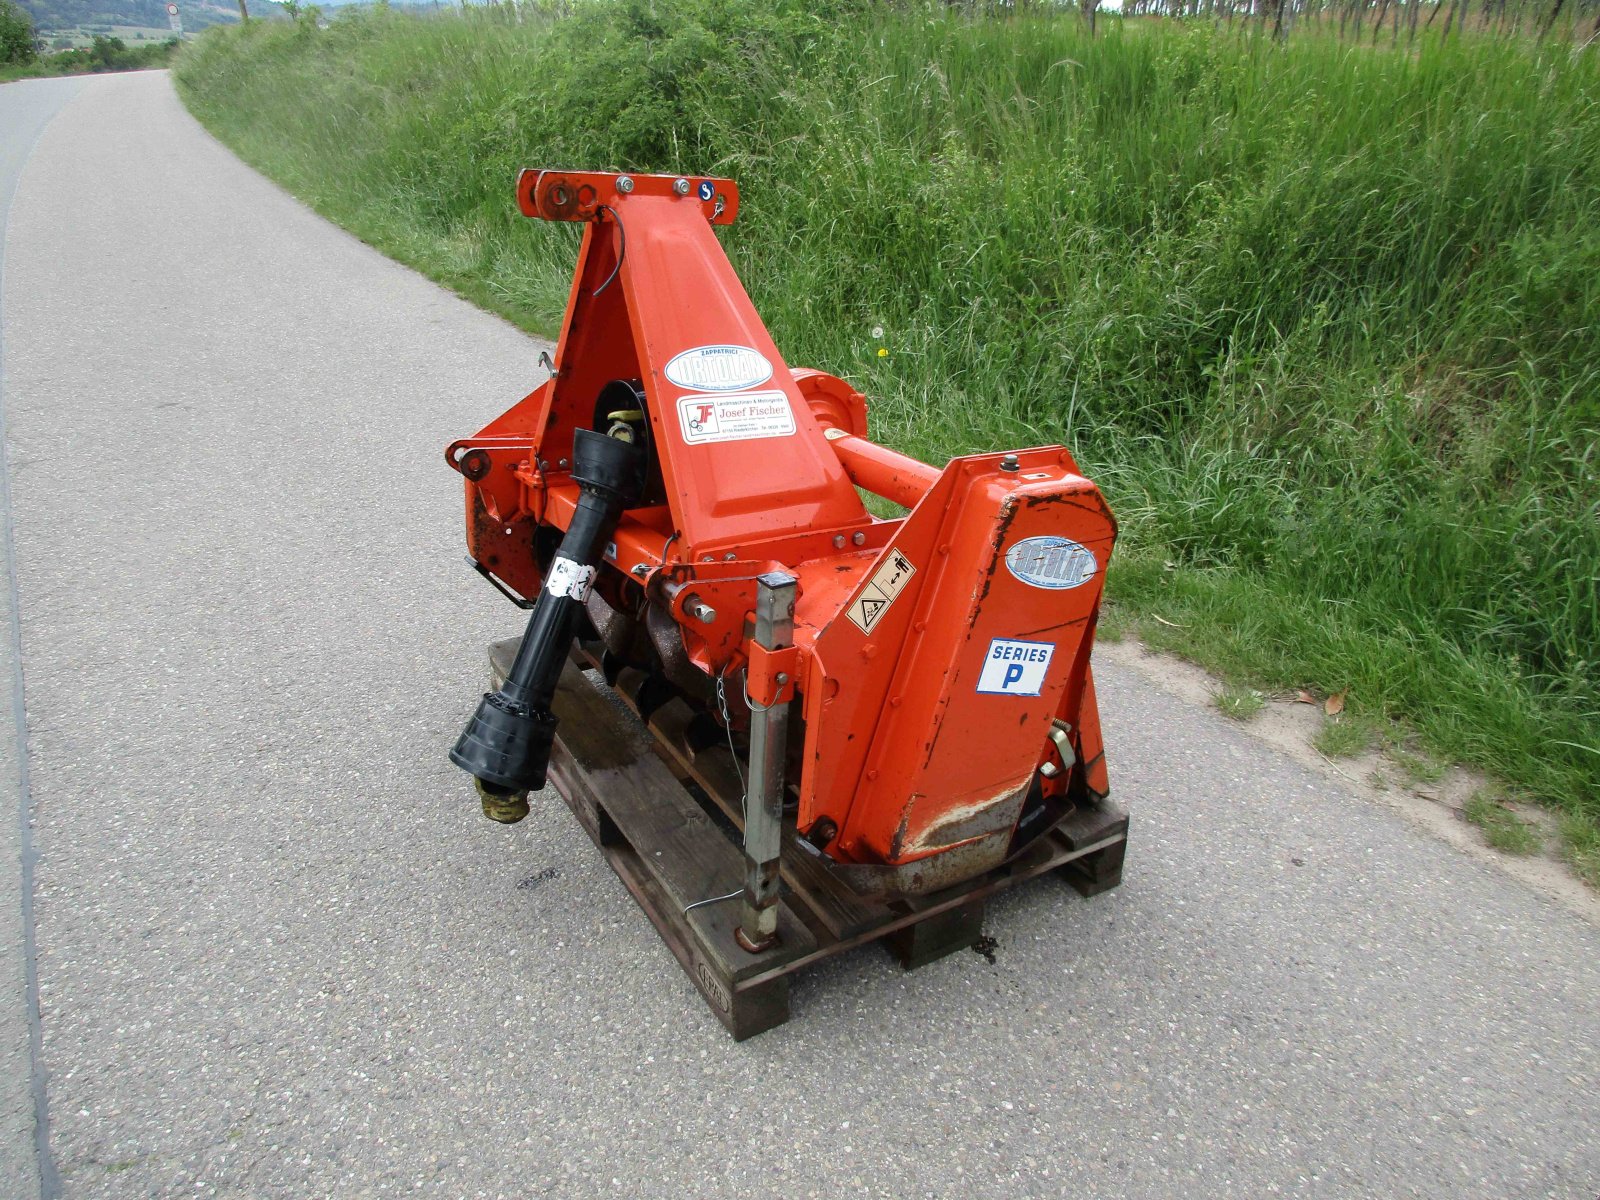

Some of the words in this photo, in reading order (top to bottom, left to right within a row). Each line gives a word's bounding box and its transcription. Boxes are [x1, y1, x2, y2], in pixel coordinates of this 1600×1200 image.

[701, 348, 738, 356] ZAPPATRICI
[720, 407, 747, 418] Josef
[749, 406, 785, 416] Fischer
[993, 646, 1047, 662] SERIES
[1002, 664, 1024, 688] P
